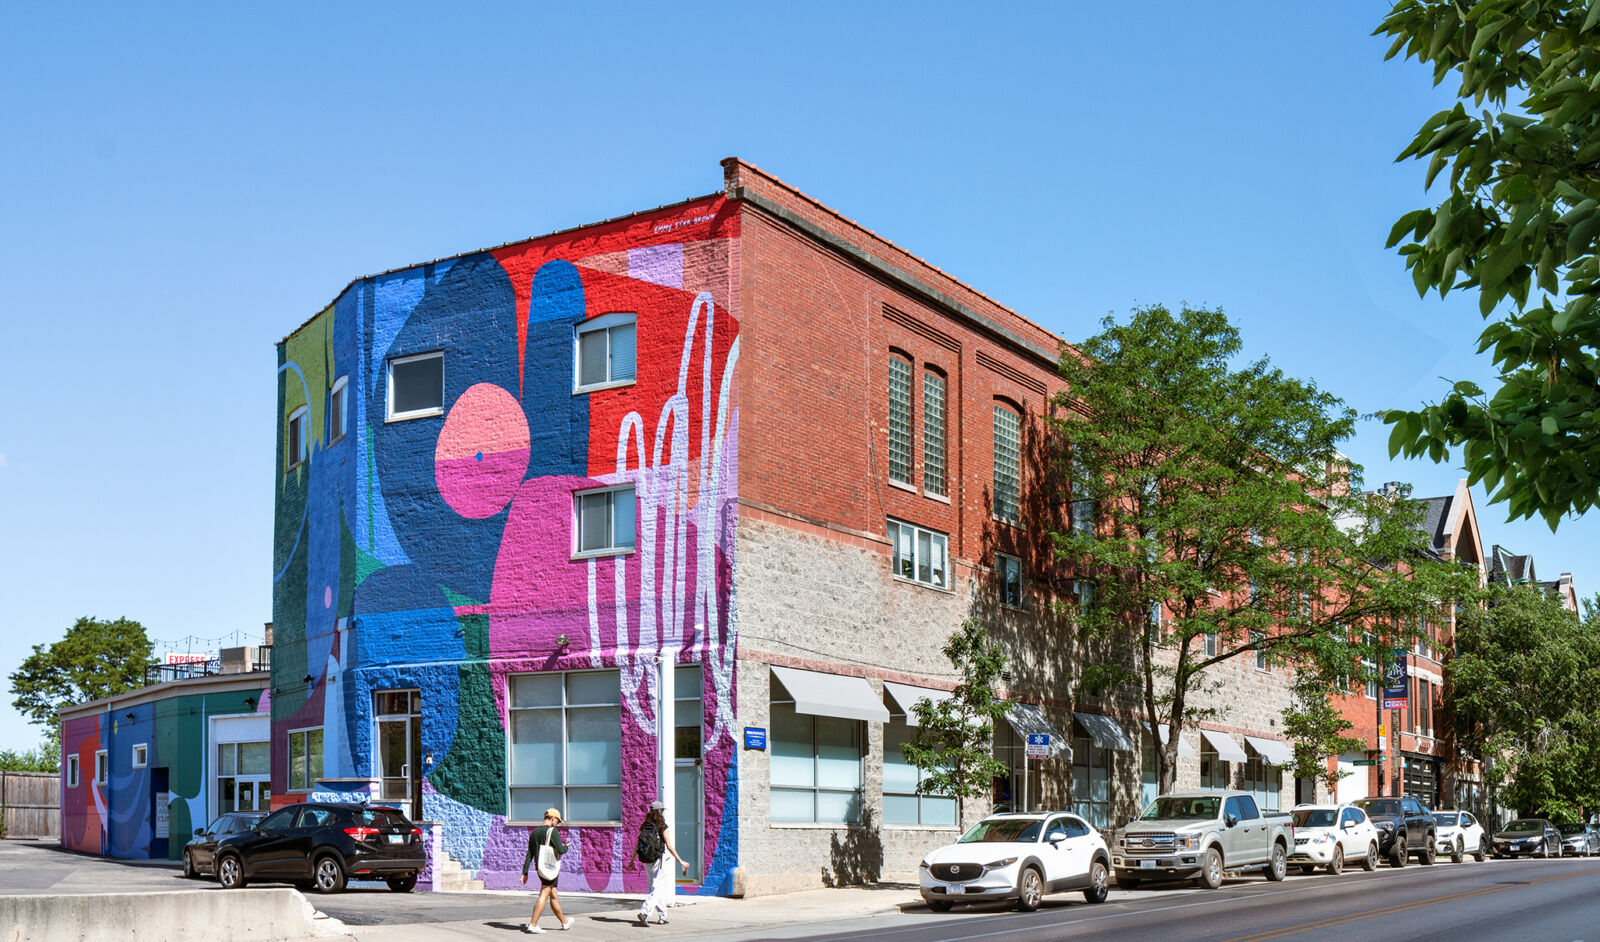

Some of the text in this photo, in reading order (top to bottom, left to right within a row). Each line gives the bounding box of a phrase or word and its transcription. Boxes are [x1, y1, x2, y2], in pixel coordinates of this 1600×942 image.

[654, 213, 715, 234] EMMY STAR BROWN
[169, 655, 205, 666] EXPRESS
